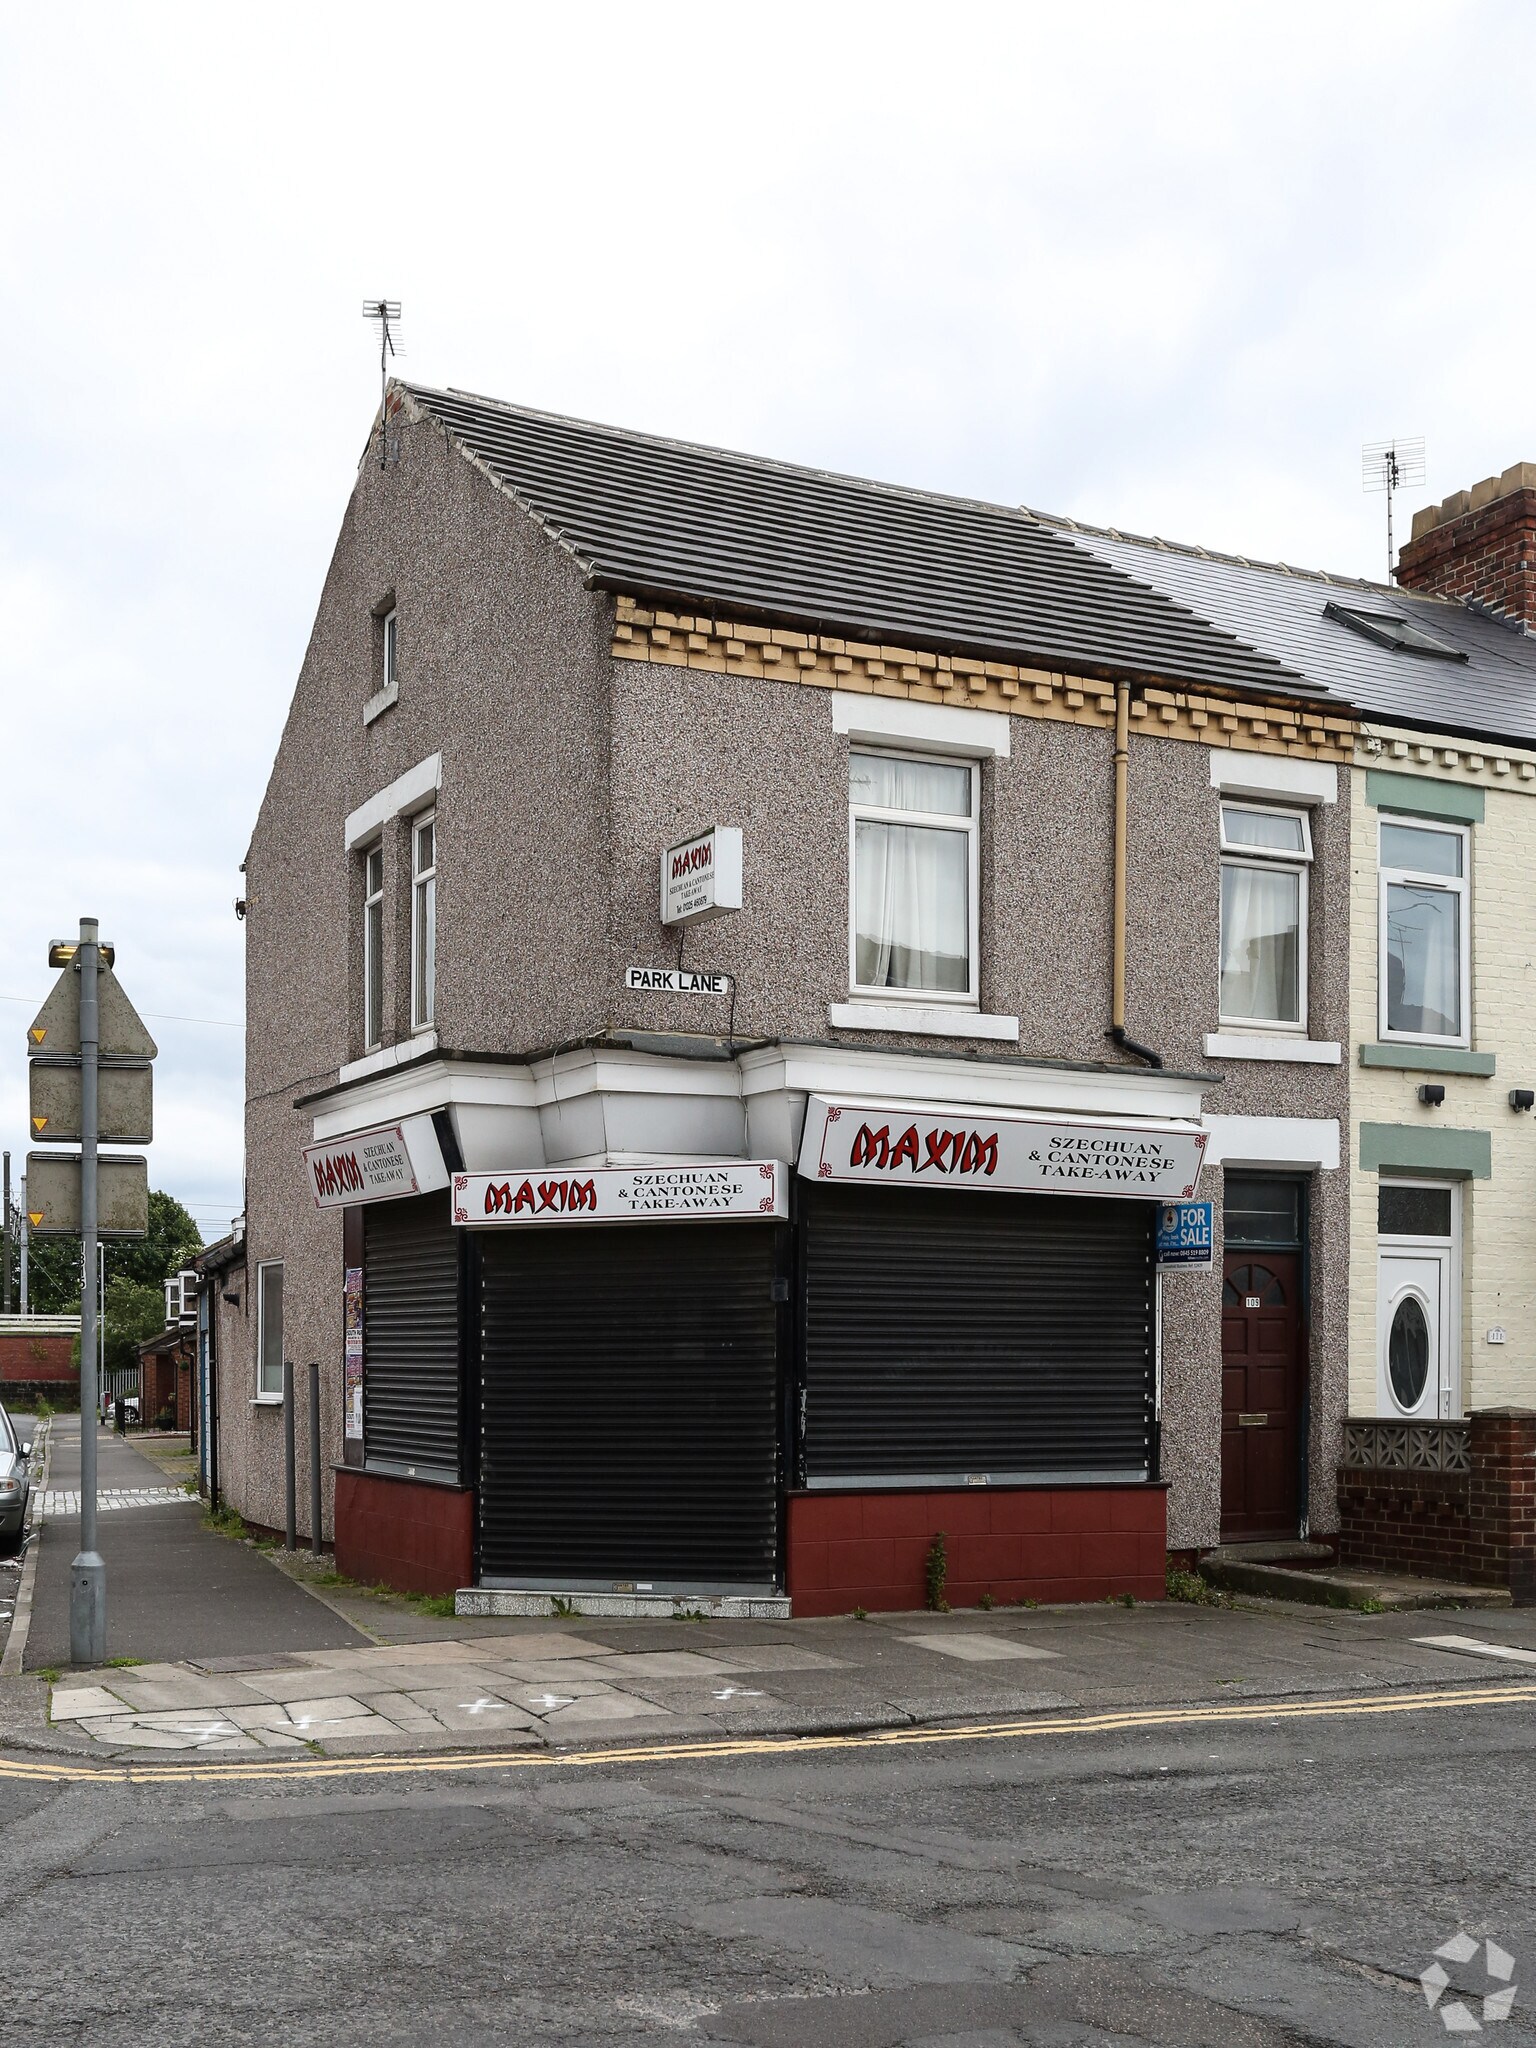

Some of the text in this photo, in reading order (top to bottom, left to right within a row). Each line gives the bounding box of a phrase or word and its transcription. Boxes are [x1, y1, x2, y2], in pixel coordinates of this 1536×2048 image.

[672, 841, 712, 880] MAXIM
[631, 970, 723, 993] PARK LANE
[363, 1141, 395, 1159] SZECHUAN
[850, 1122, 998, 1176] MAXIM
[1048, 1136, 1163, 1155] SZECHUAN
[362, 1154, 404, 1173] & CANTONESE
[1028, 1150, 1175, 1170] & CANTONESE
[313, 1151, 364, 1197] MAXIM
[632, 1172, 729, 1186] SZECHUAN
[1038, 1164, 1162, 1183] TAKE-AWAY
[484, 1178, 597, 1214] MAXIM
[618, 1184, 744, 1198] & CANTONESE
[628, 1197, 733, 1210] TAKE-AWAY
[1180, 1208, 1206, 1227] FOR
[1180, 1227, 1210, 1246] SALE
